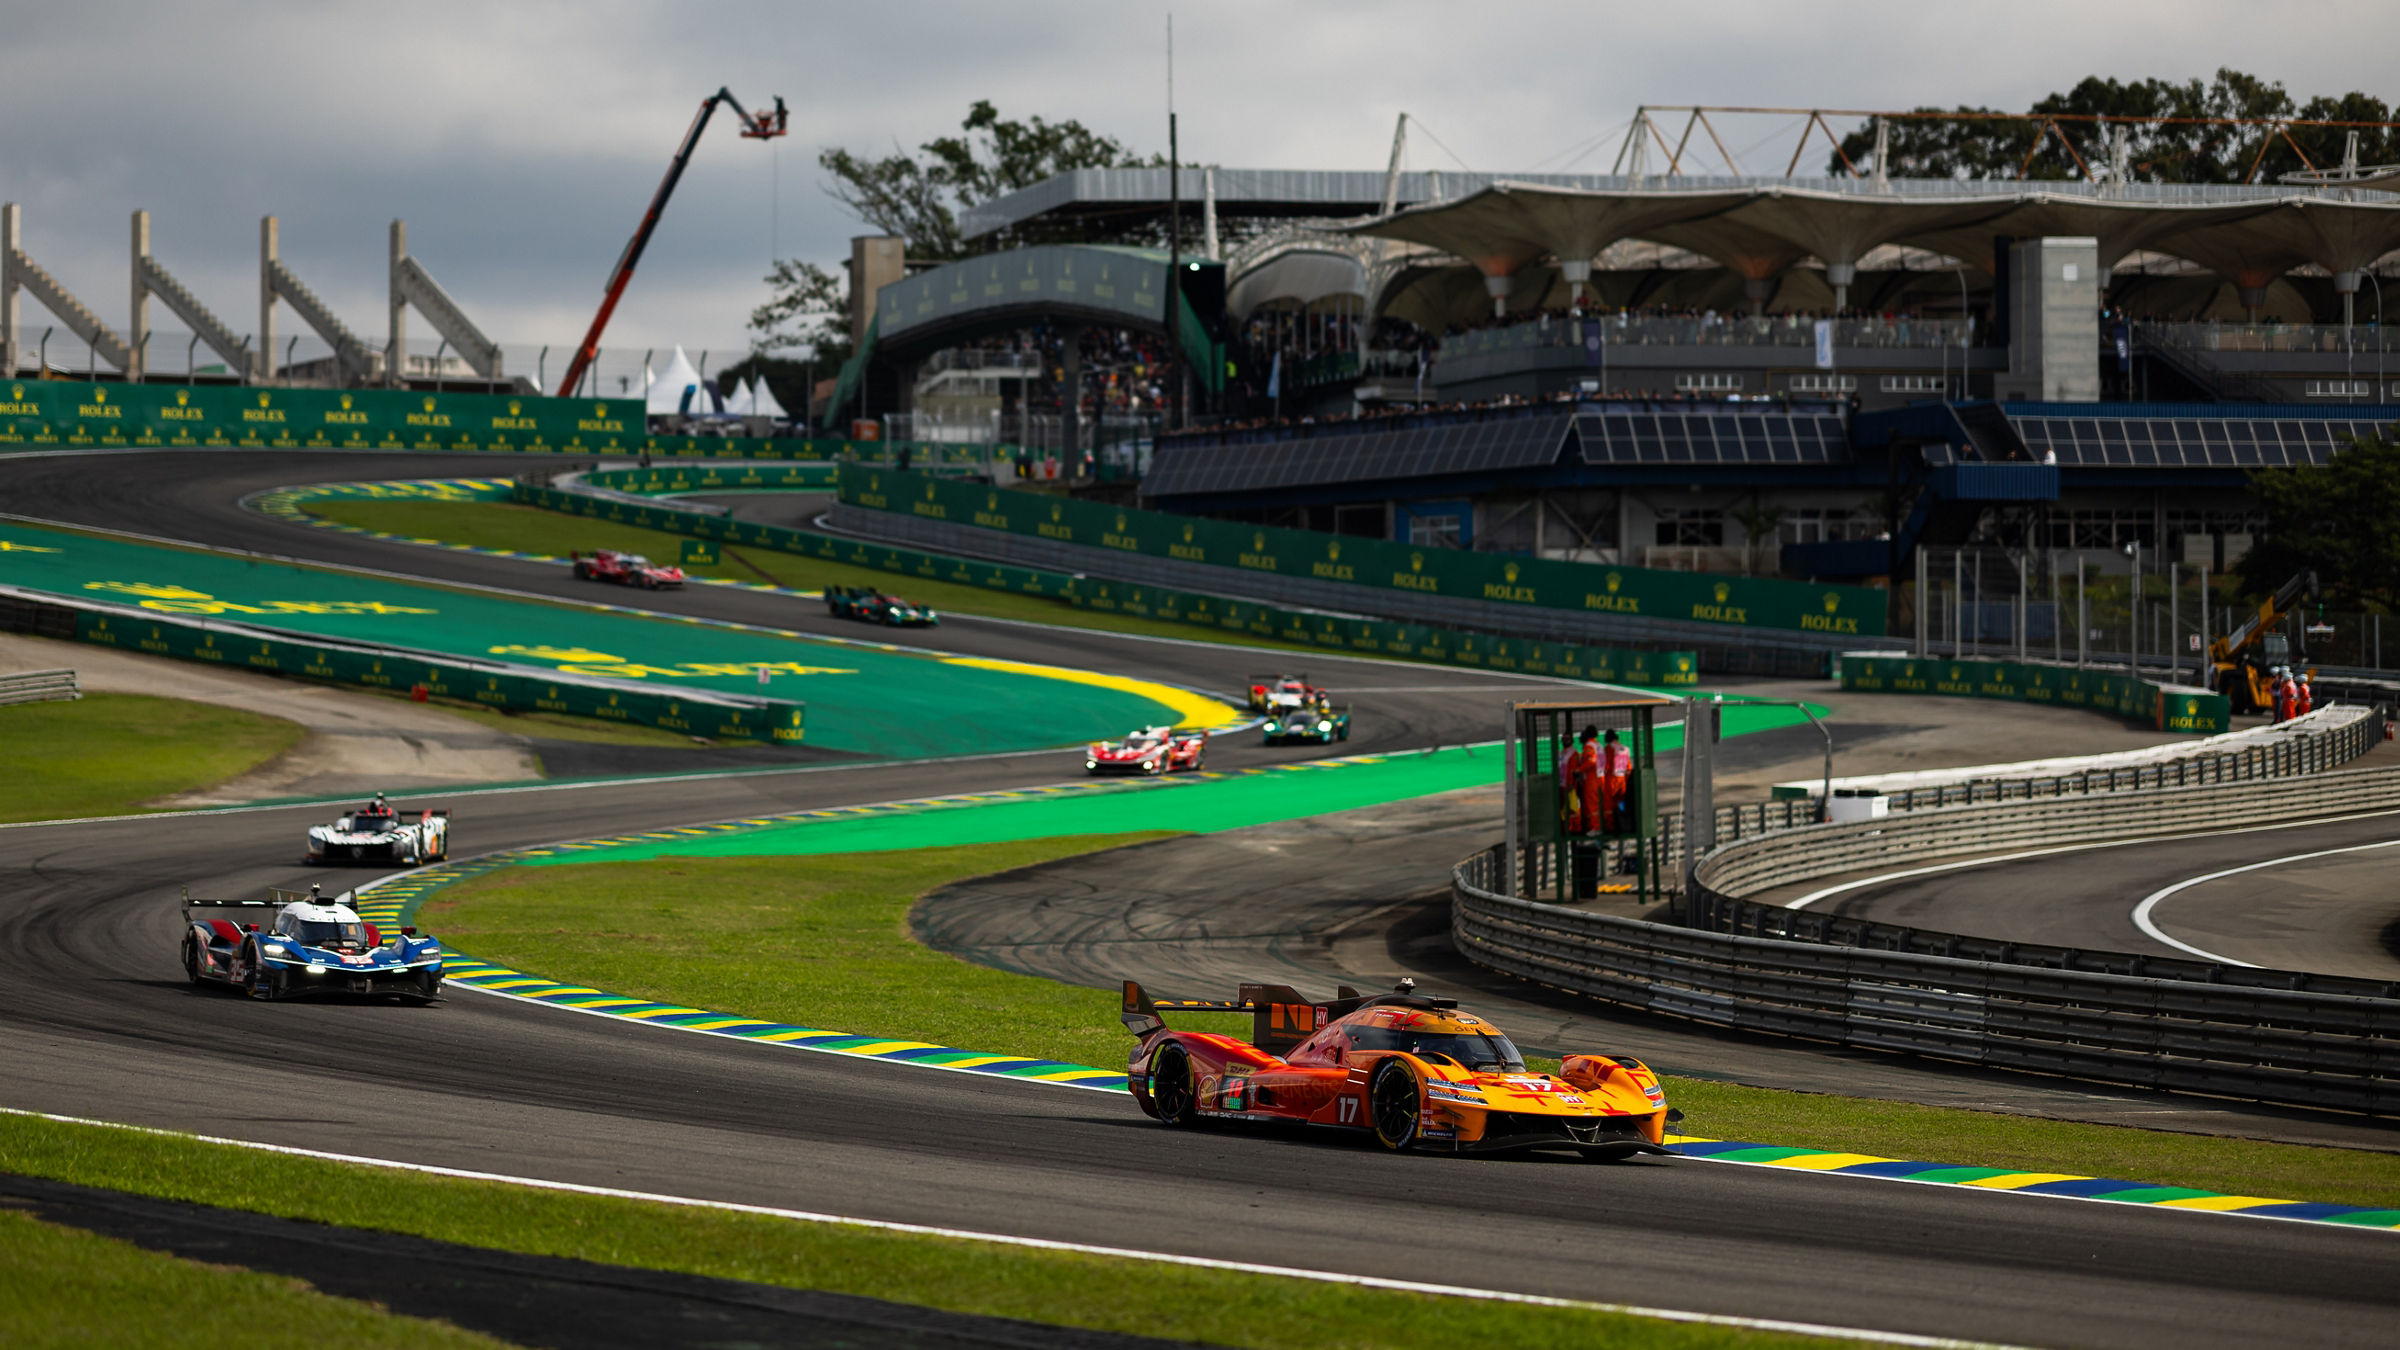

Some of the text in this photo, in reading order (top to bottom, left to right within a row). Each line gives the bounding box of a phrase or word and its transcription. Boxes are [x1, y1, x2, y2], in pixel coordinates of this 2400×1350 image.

[79, 405, 121, 418] ROLEX
[161, 407, 203, 420] ROLEX
[243, 409, 286, 422] ROLEX
[325, 412, 368, 424] ROLEX
[407, 413, 451, 426] ROLEX
[492, 417, 536, 430] ROLEX
[578, 419, 623, 432] ROLEX
[914, 501, 946, 518] ROLEX
[974, 511, 1007, 529] ROLEX
[1038, 522, 1072, 539] ROLEX
[1102, 532, 1137, 550] ROLEX
[1169, 544, 1204, 560] ROLEX
[1239, 553, 1276, 570] ROLEX
[1313, 562, 1354, 580] ROLEX
[1393, 572, 1437, 592] ROLEX
[1484, 584, 1535, 603] ROLEX
[1586, 593, 1638, 612] ROLEX
[1693, 604, 1746, 624] ROLEX
[1802, 614, 1858, 634] ROLEX
[2170, 716, 2215, 730] ROLEX
[1316, 1012, 1326, 1024] HY
[1230, 1066, 1250, 1074] DHL
[1523, 1083, 1552, 1091] 17
[1339, 1097, 1358, 1122] 17
